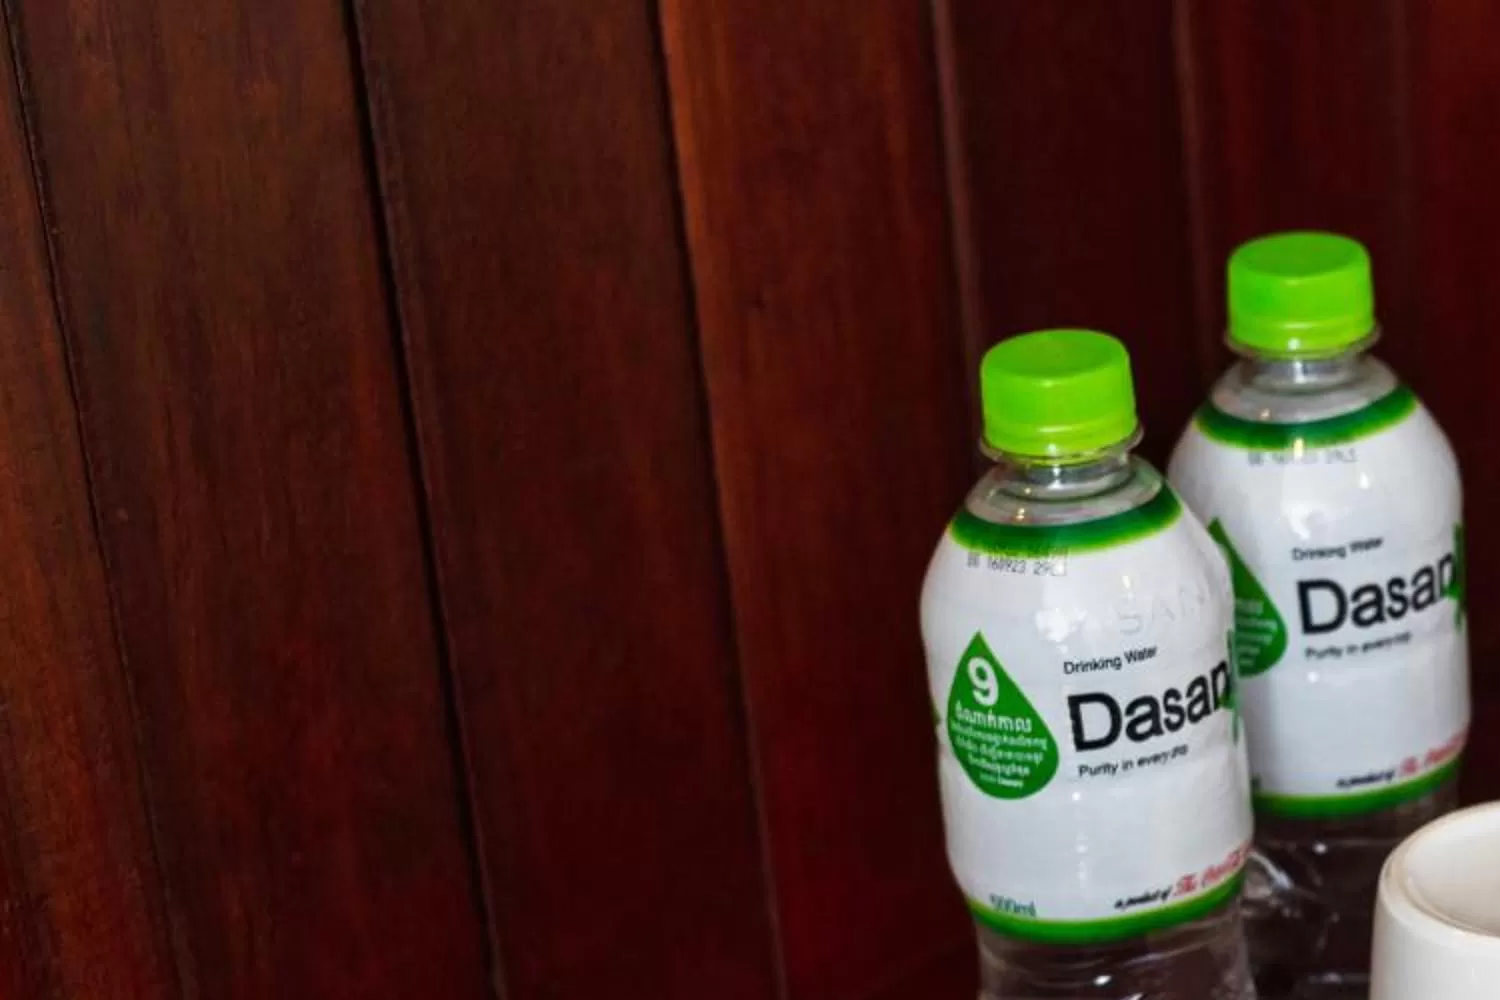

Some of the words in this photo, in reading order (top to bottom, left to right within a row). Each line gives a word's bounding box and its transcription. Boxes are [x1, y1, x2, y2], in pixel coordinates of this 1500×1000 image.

[1297, 552, 1457, 636] Dasan
[966, 656, 999, 707] 9
[1063, 656, 1123, 676] Drinking
[1124, 645, 1159, 664] Water
[1067, 660, 1232, 753] Dasan
[1078, 763, 1119, 777] Purity
[1122, 755, 1135, 772] in
